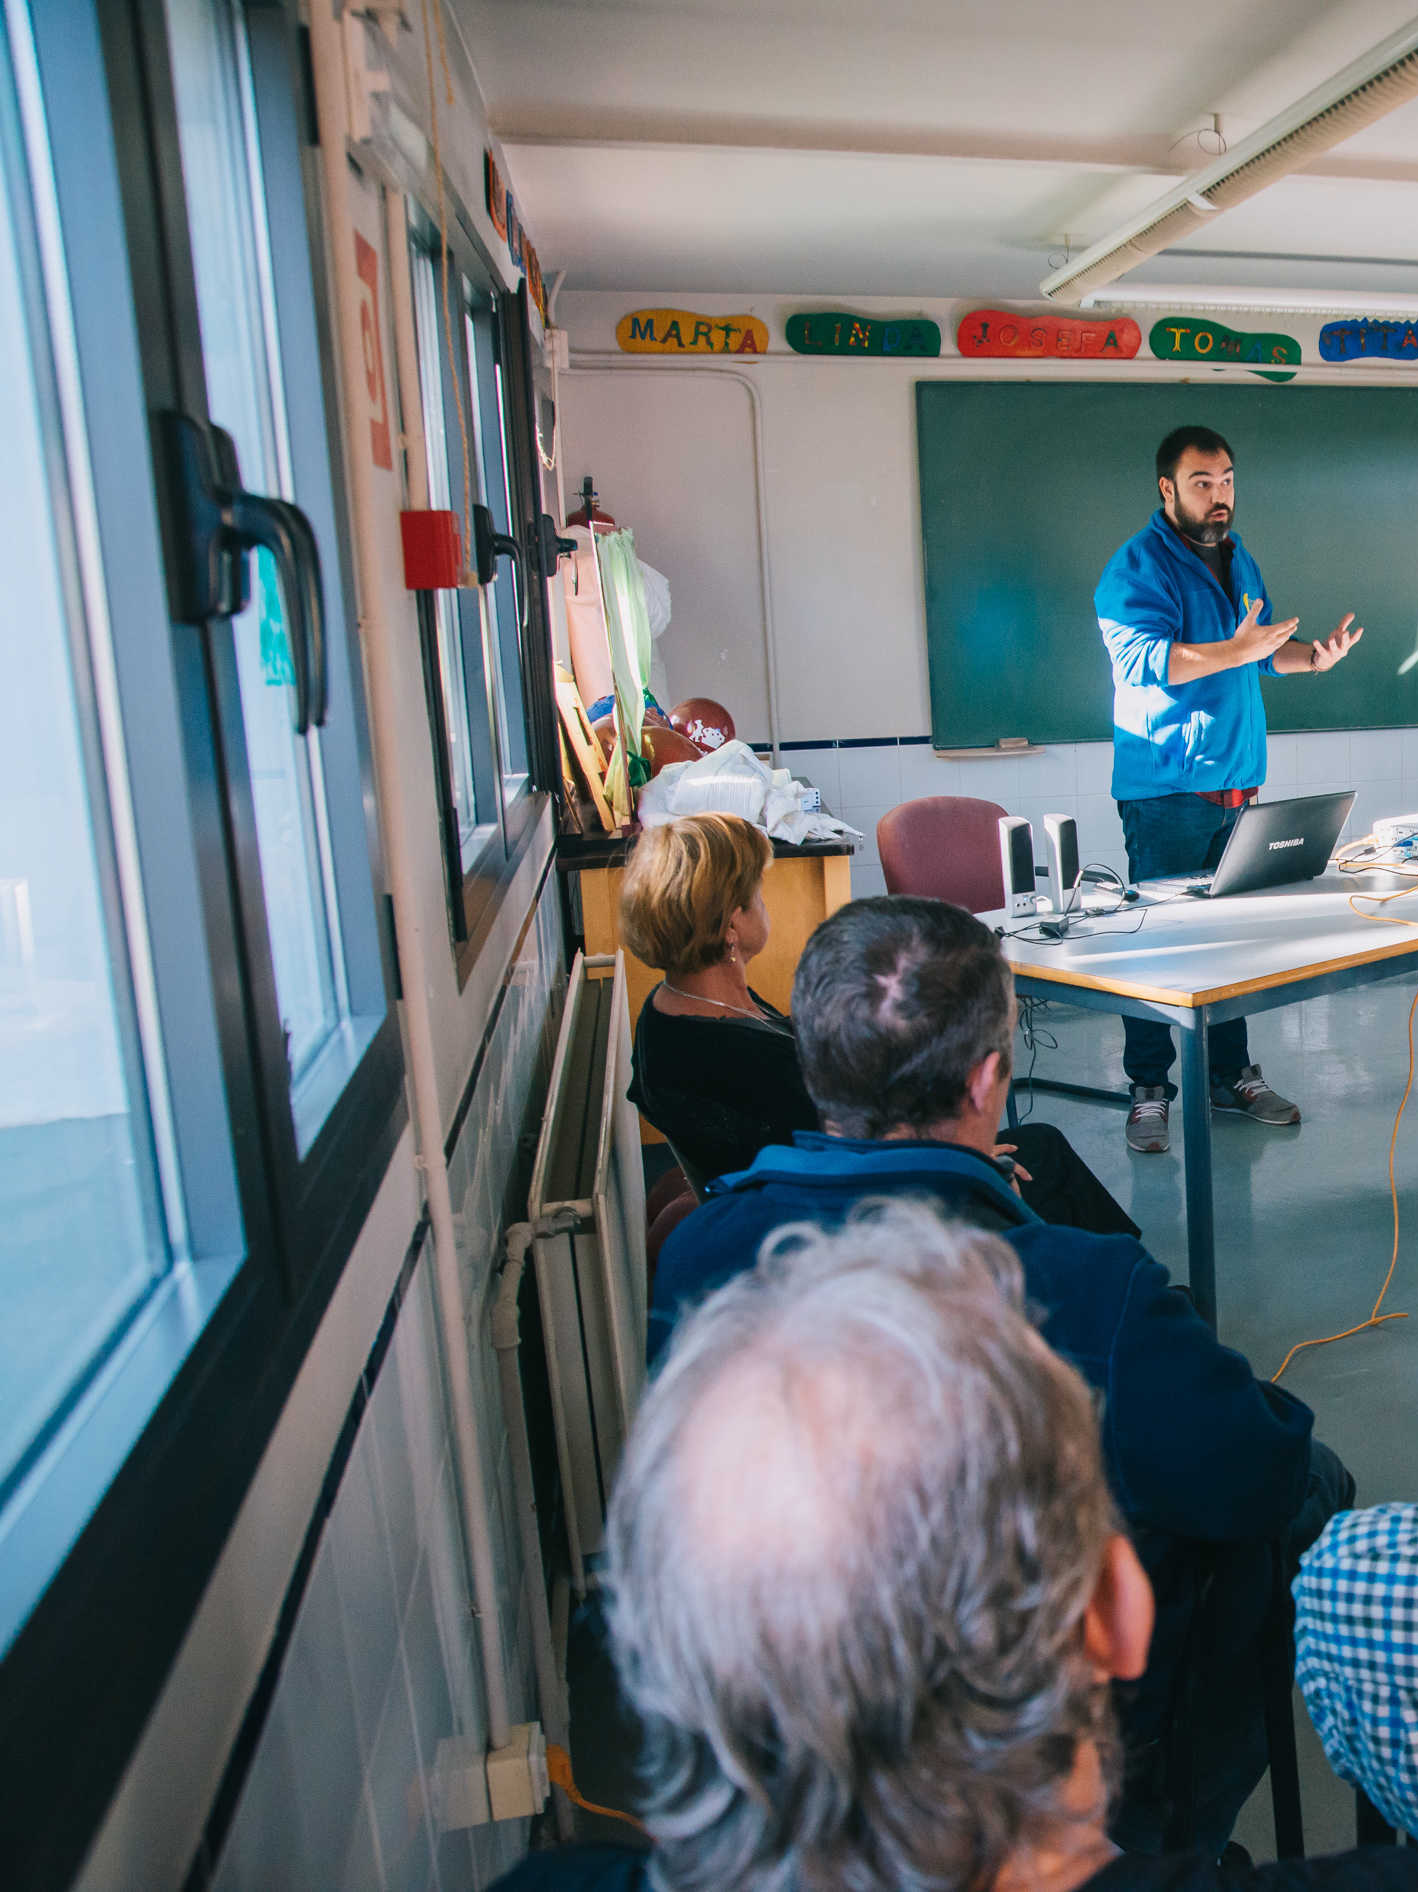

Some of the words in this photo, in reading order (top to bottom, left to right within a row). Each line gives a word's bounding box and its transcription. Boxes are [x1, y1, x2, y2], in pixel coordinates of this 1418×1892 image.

[629, 317, 760, 354] MARTA
[804, 320, 928, 352] LINDA
[972, 321, 1122, 354] JOSEFA
[1268, 838, 1304, 851] TOSHIBA
